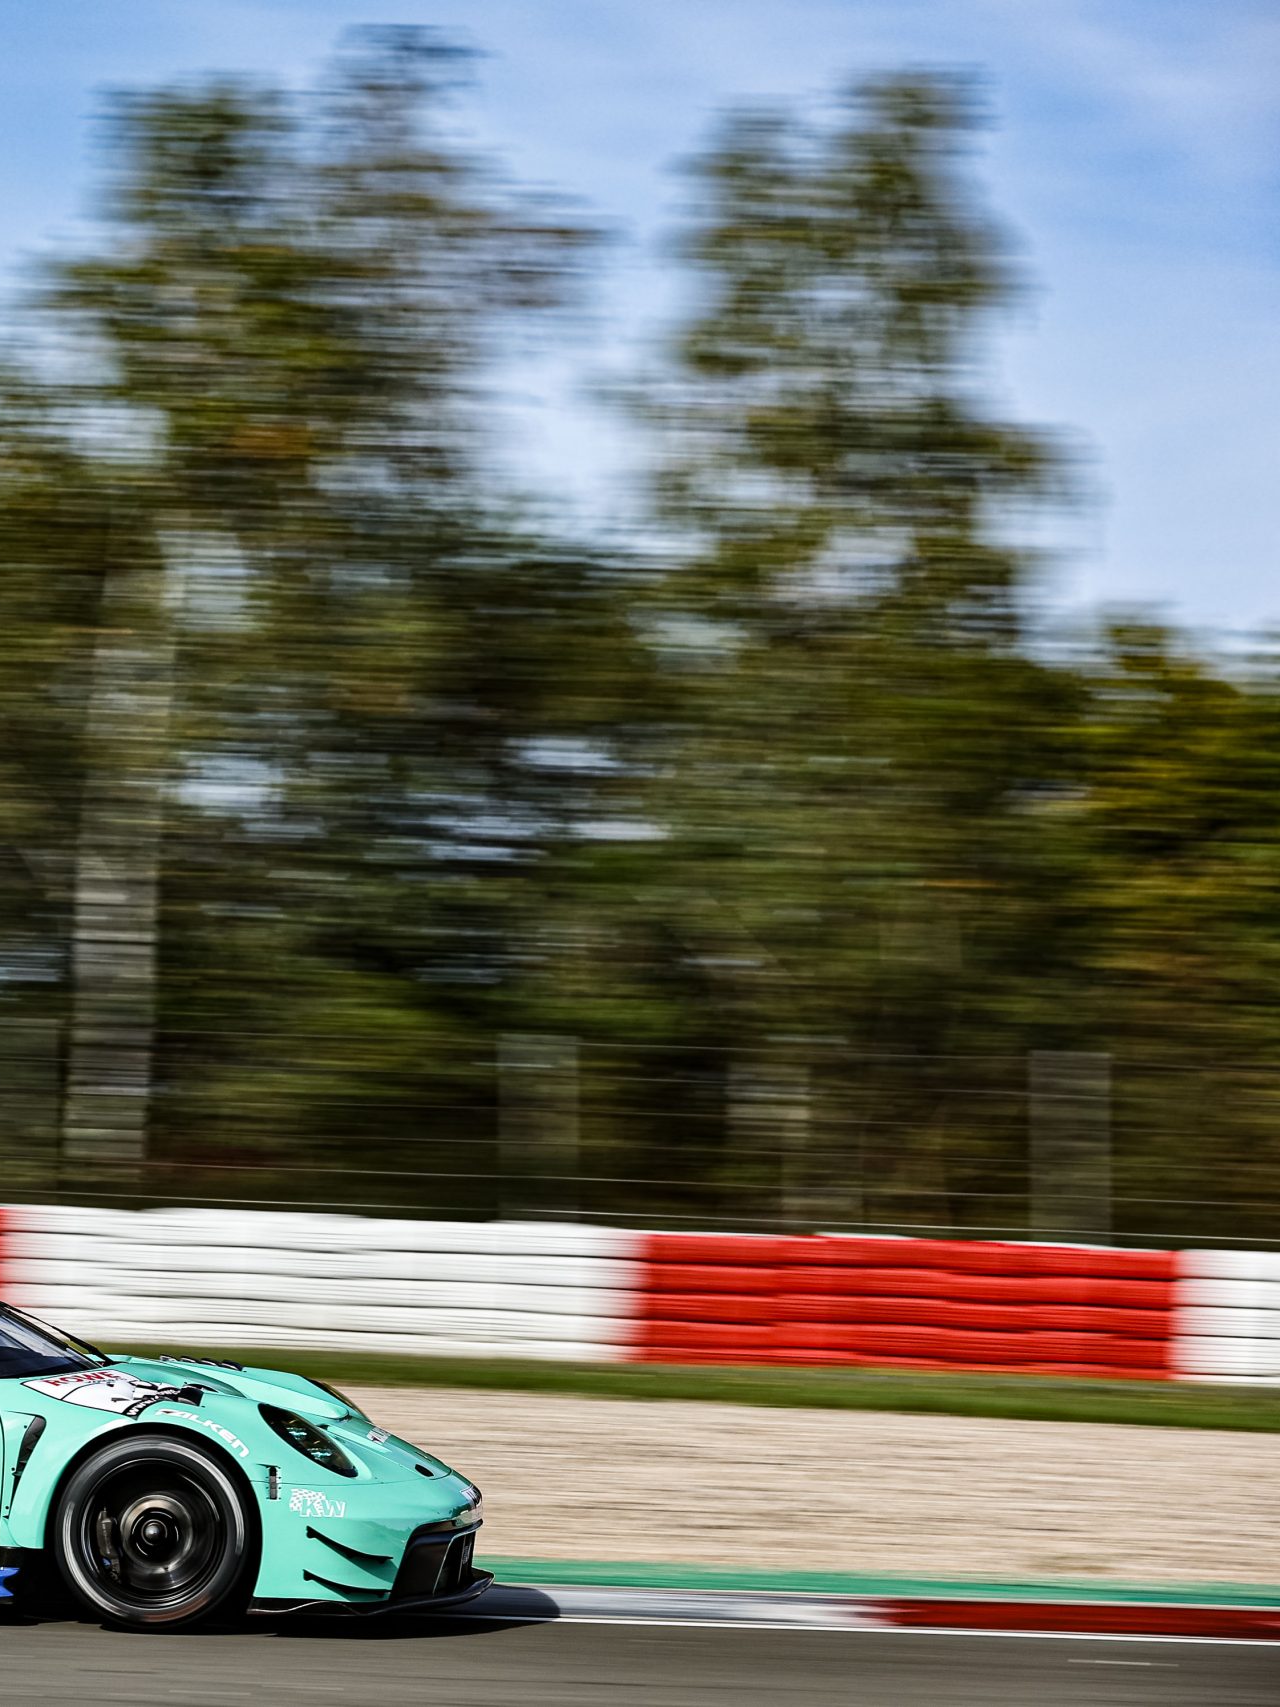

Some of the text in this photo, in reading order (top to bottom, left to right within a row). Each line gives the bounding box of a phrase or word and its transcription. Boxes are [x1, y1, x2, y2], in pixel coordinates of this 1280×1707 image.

[42, 1371, 121, 1387] ROWE
[155, 1408, 251, 1458] FALKEN
[299, 1499, 347, 1518] KW
